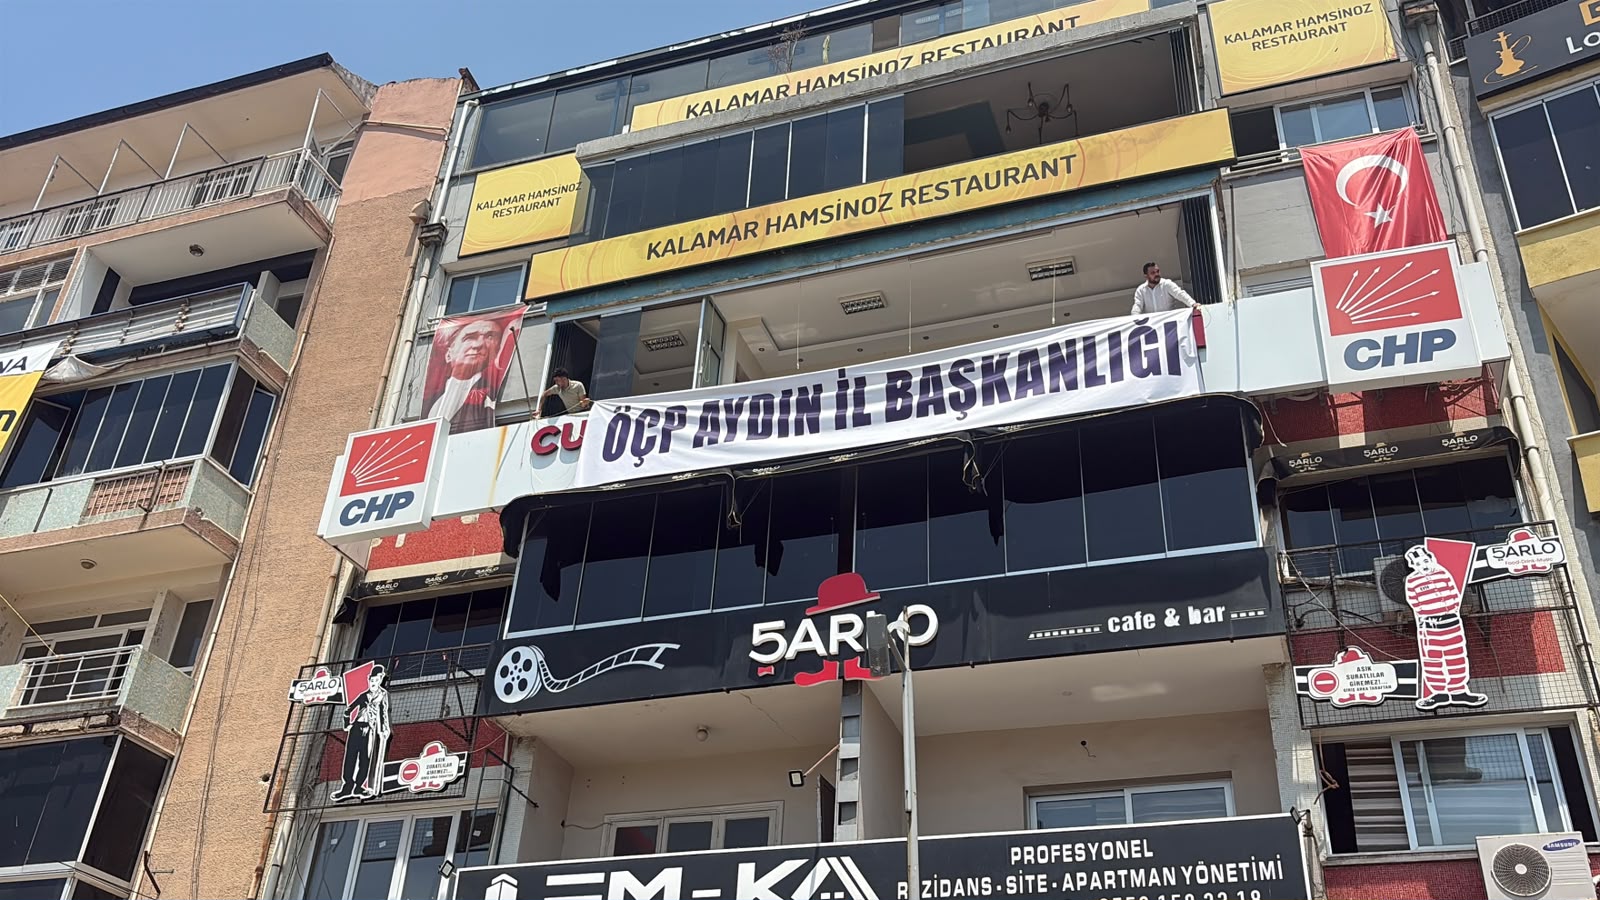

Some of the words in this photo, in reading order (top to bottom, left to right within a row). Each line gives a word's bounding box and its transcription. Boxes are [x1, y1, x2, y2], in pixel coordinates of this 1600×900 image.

[1224, 21, 1293, 45] KALAMAR
[1296, 3, 1374, 29] HAMSİNOZ
[1252, 22, 1347, 51] RESTAURANT
[686, 84, 789, 119] KALAMAR
[796, 56, 914, 95] HAMSİNOZ
[921, 15, 1081, 65] RESTAURANT
[476, 194, 526, 212] KALAMAR
[528, 182, 582, 201] HAMSİNOZ
[492, 197, 562, 218] RESTAURANT
[646, 221, 759, 261] KALAMAR
[765, 192, 893, 236] HAMSİNOZ
[900, 153, 1077, 208] RESTAURANT
[1344, 329, 1456, 371] CHP
[602, 404, 687, 467] ÖÇP
[693, 383, 823, 449] AYDIN
[835, 368, 871, 430] İL
[885, 316, 1182, 421] BAŞKANLIĞI
[340, 490, 414, 526] CHP
[749, 604, 938, 664] 5ARO
[1108, 611, 1155, 633] cafe
[1164, 608, 1180, 627] &
[1188, 605, 1226, 625] bar
[1010, 839, 1153, 866] PROFESYONEL
[897, 874, 992, 900] RZİDANS
[1180, 854, 1284, 886] YÖNETİMİ
